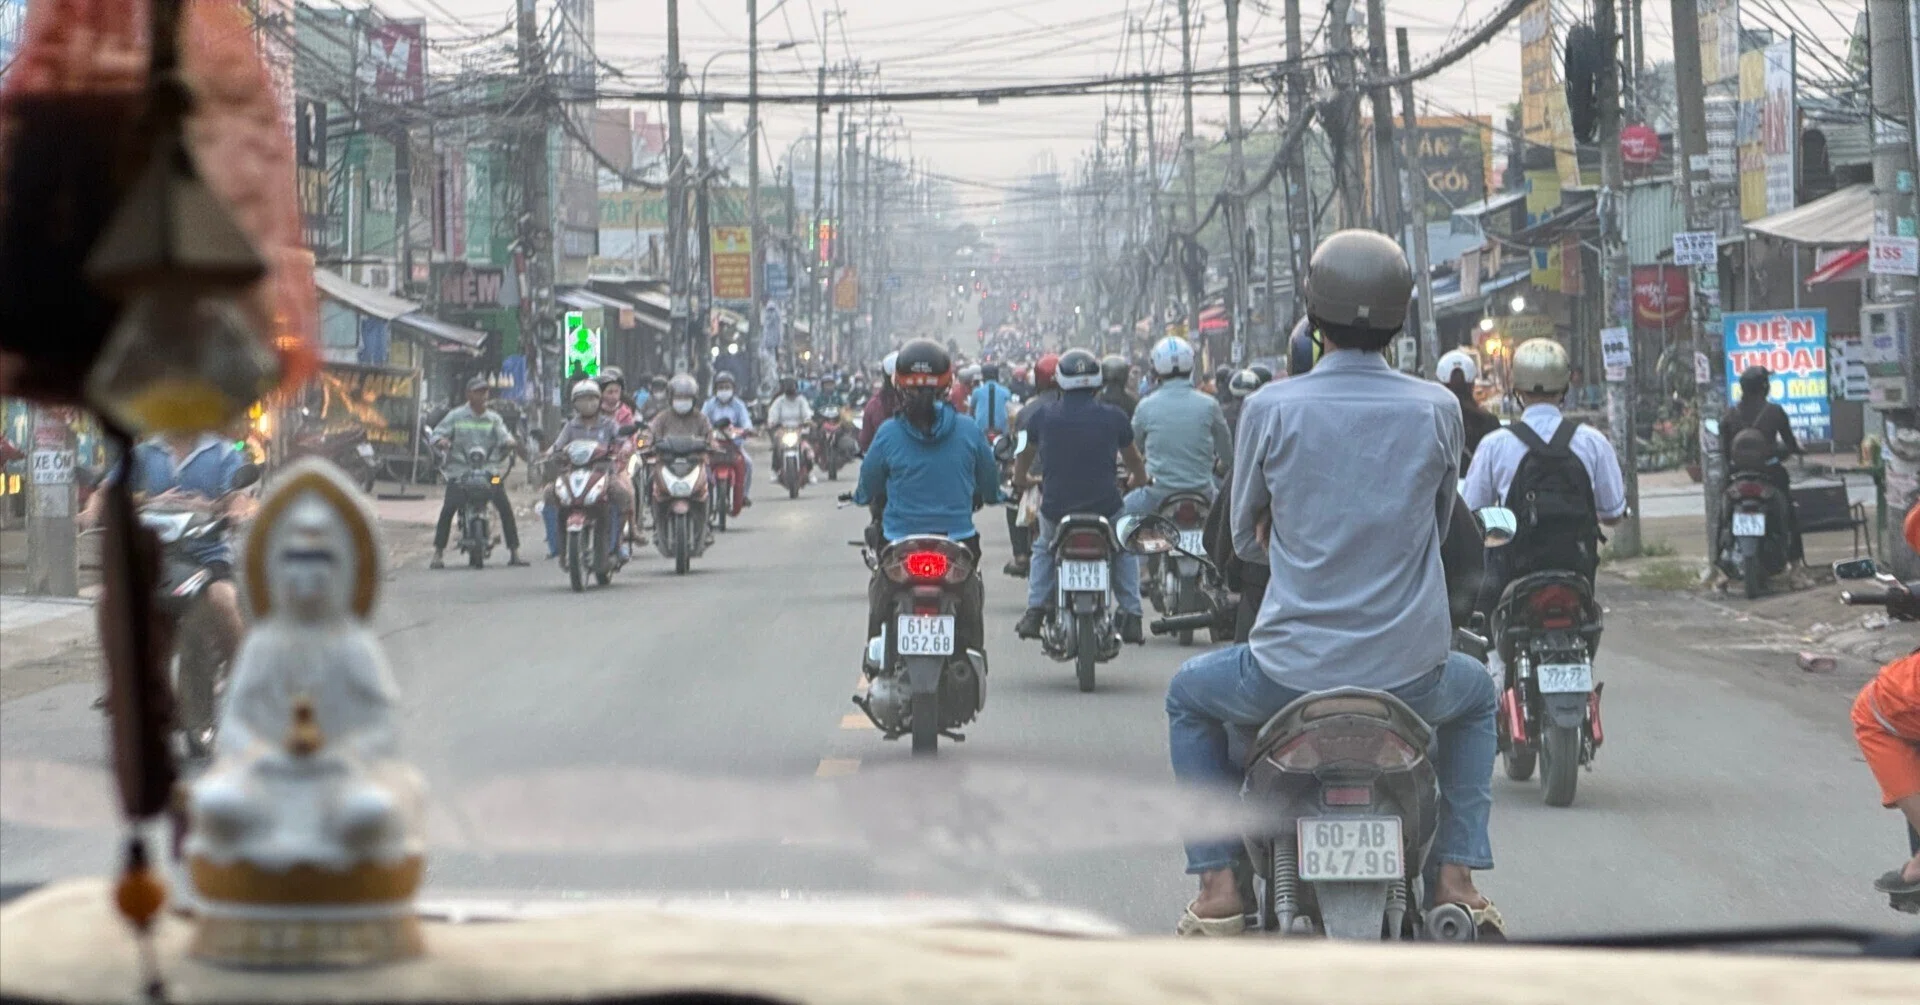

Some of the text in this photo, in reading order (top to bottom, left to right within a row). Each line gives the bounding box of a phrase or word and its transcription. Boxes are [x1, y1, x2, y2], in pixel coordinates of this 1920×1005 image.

[443, 269, 501, 309] NỆM
[1736, 315, 1815, 347] ĐIỆN
[1729, 347, 1827, 378] THOẠI
[35, 454, 50, 470] XE
[902, 636, 950, 652] 052.68
[1315, 823, 1386, 848] 60-AB
[1306, 850, 1397, 876] 847.96
